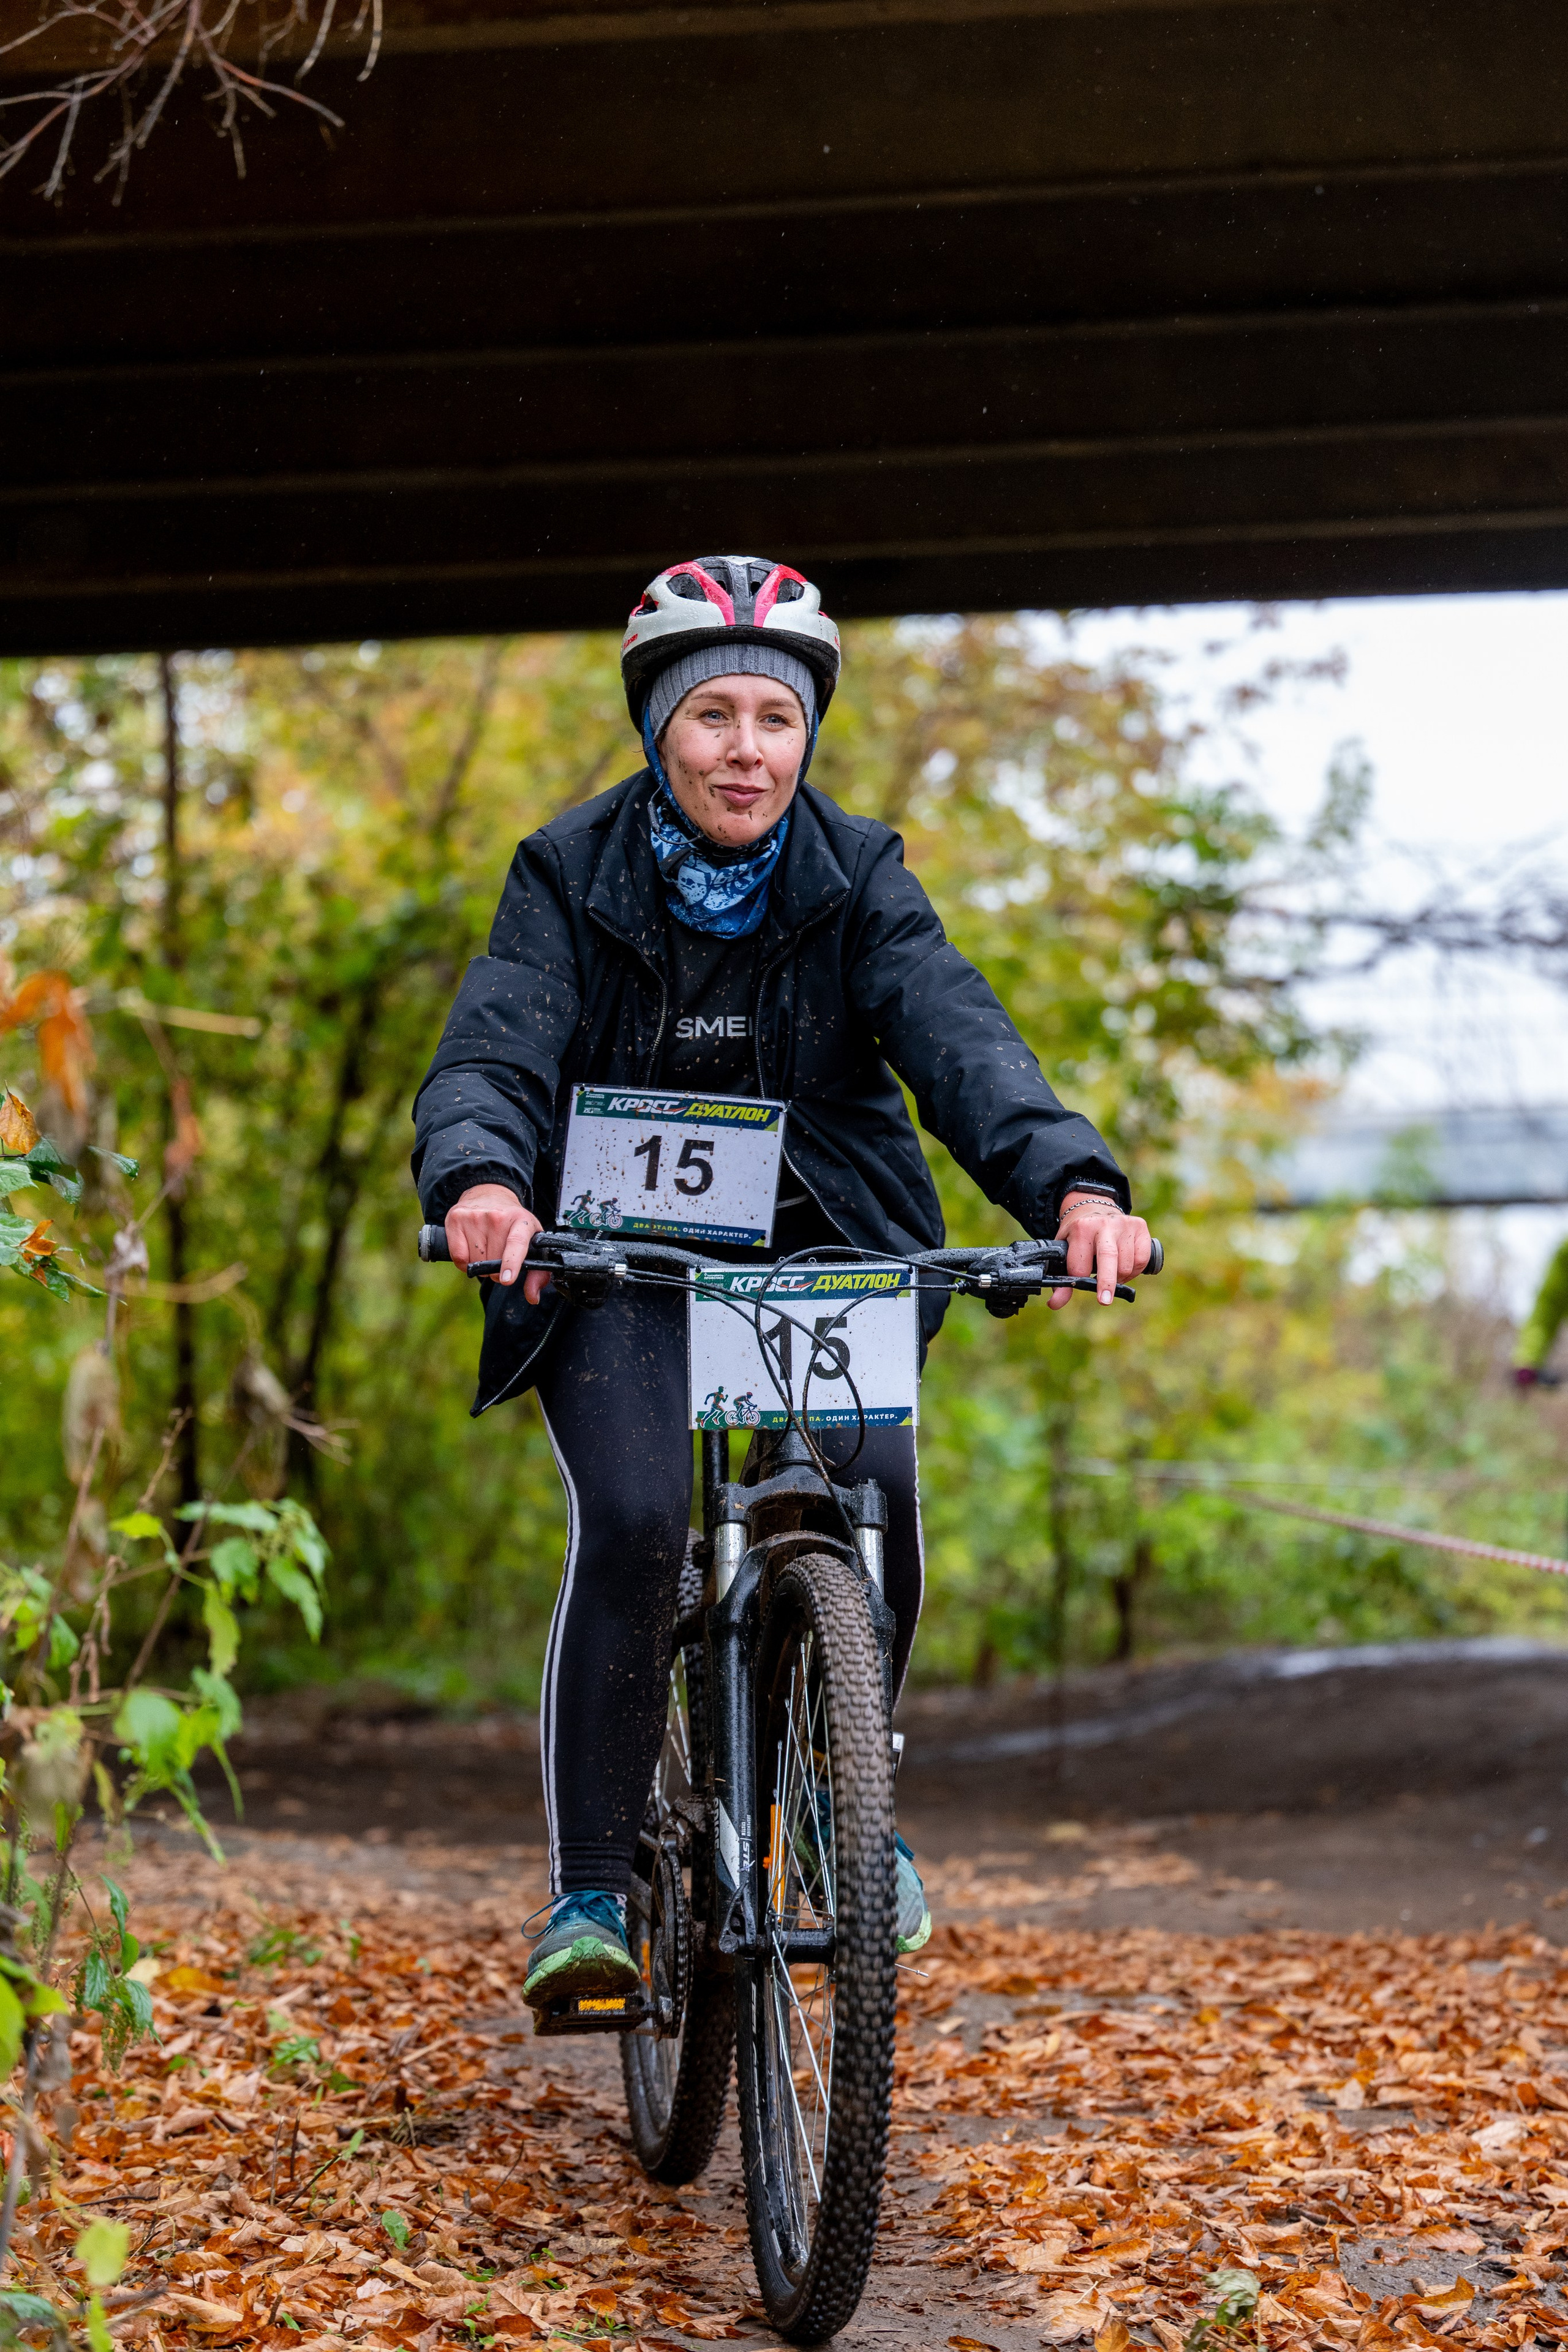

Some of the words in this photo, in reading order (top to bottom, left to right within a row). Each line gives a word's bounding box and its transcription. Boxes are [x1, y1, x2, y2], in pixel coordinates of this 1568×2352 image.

[607, 1096, 687, 1116] КРОСС
[683, 1102, 771, 1122] ДУАТЛОН
[634, 1135, 715, 1196] 15
[707, 1229, 752, 1239] ХАРАКТЕР.
[729, 1276, 813, 1292] КРОСС
[811, 1273, 901, 1293] ДУАТЛОН
[762, 1316, 851, 1381] 15
